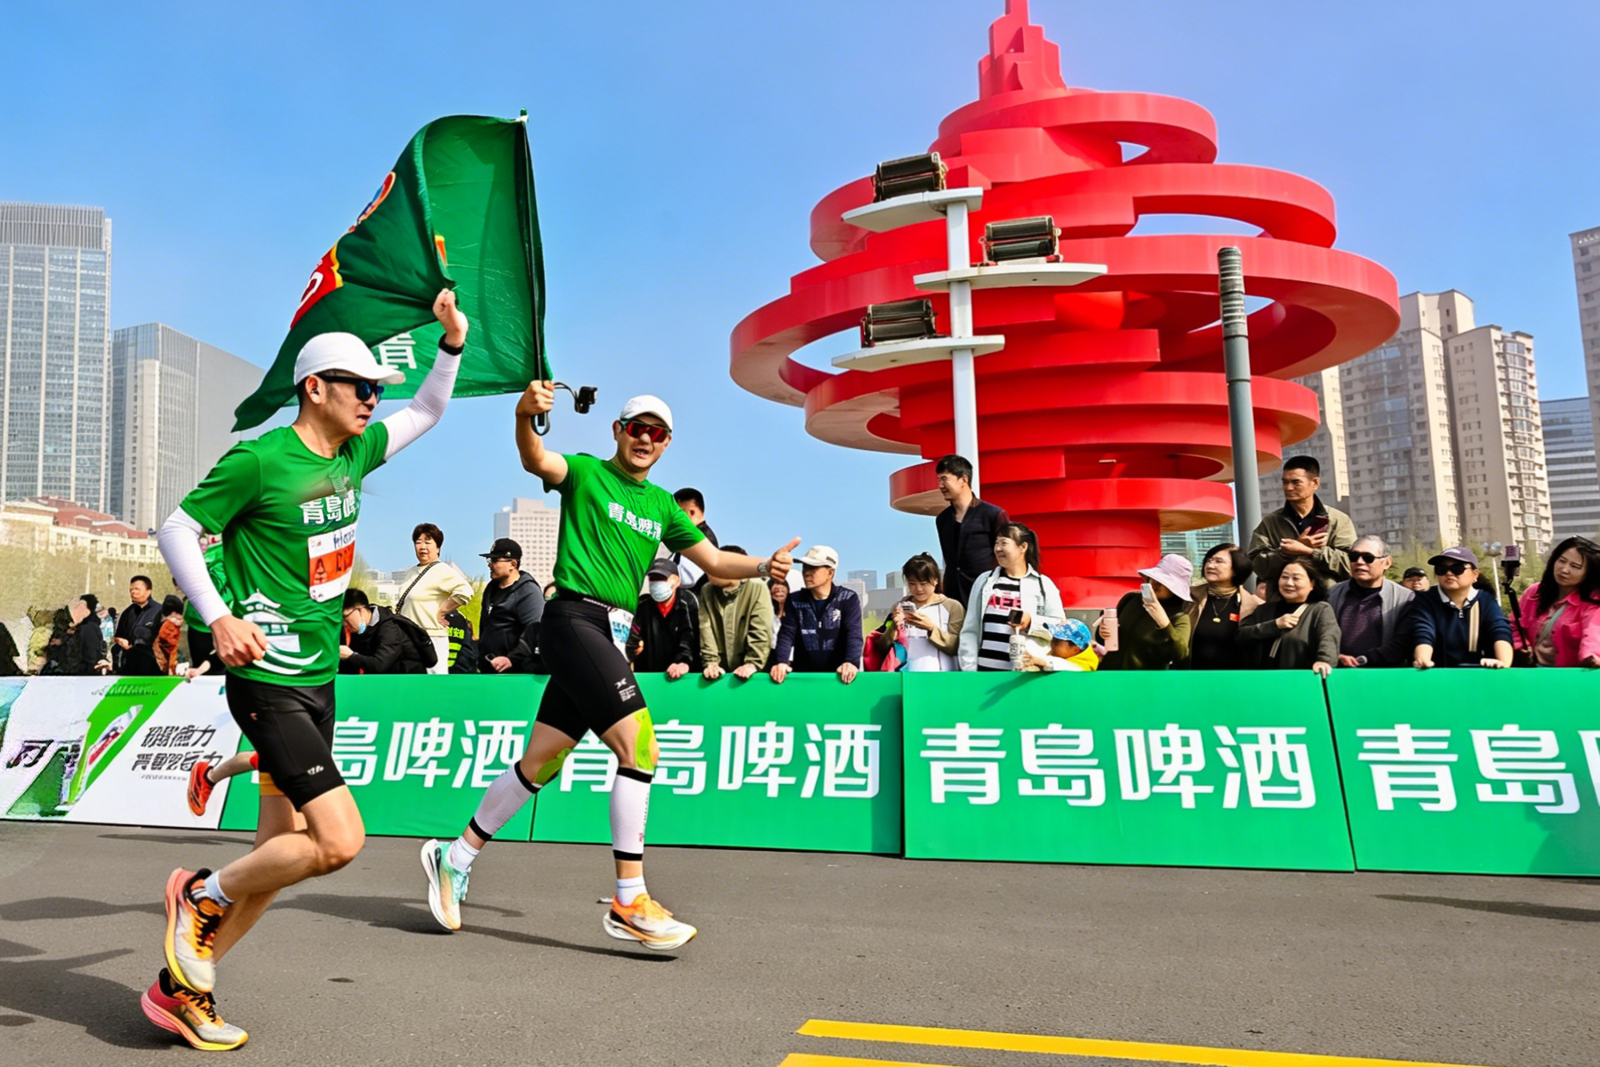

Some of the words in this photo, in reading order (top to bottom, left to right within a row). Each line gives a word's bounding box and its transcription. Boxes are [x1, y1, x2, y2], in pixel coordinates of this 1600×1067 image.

[251, 716, 528, 789] 島啤酒
[560, 719, 882, 799] 青島啤酒
[920, 722, 1317, 809] 青島啤酒
[1356, 723, 1600, 815] 青島
